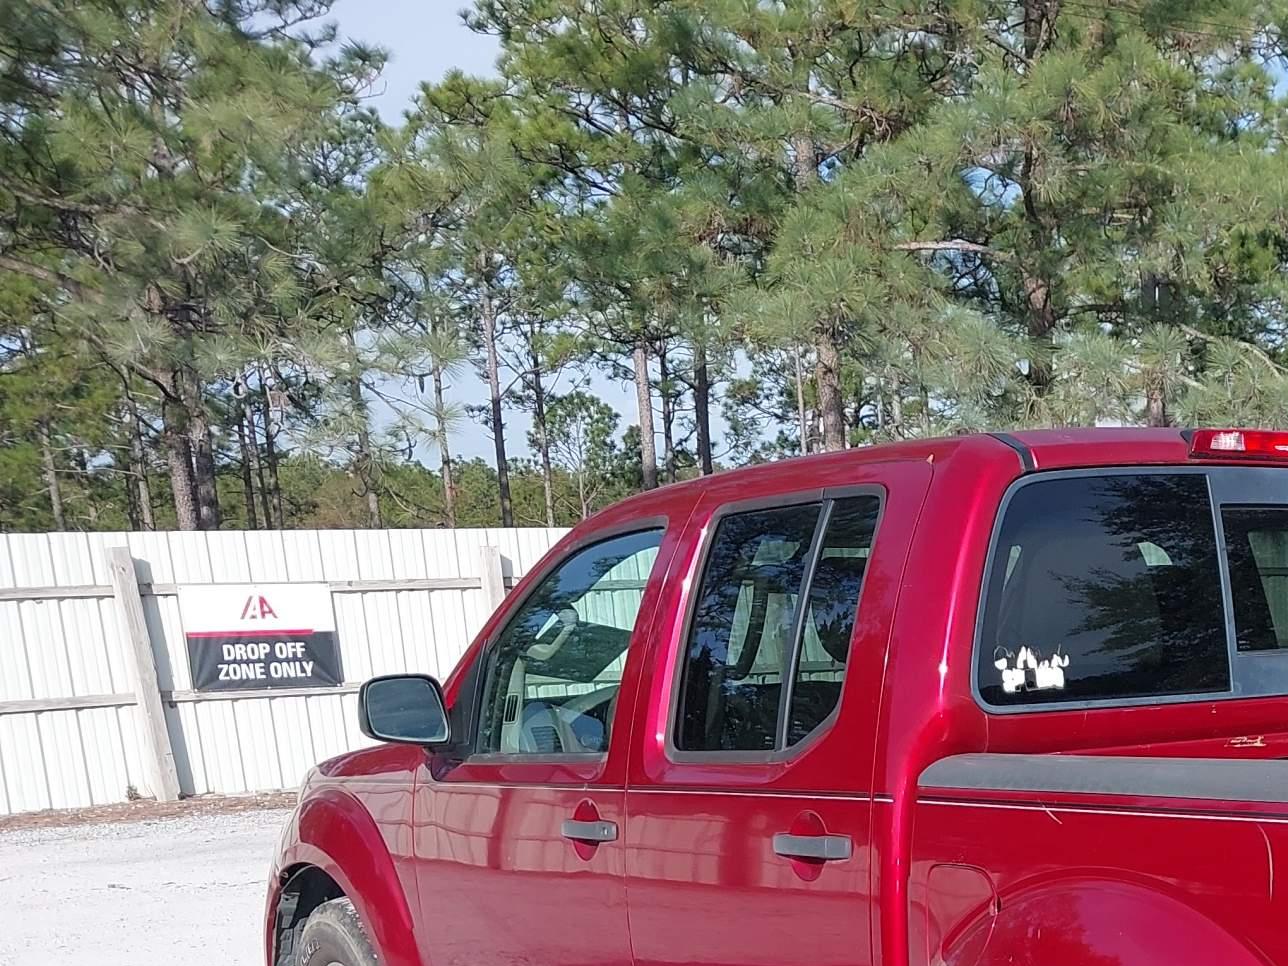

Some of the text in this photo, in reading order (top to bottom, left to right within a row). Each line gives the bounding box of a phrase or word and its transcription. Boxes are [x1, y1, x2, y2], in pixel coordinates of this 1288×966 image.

[222, 642, 306, 661] DROP OFF
[217, 661, 314, 681] ZONE ONLY
